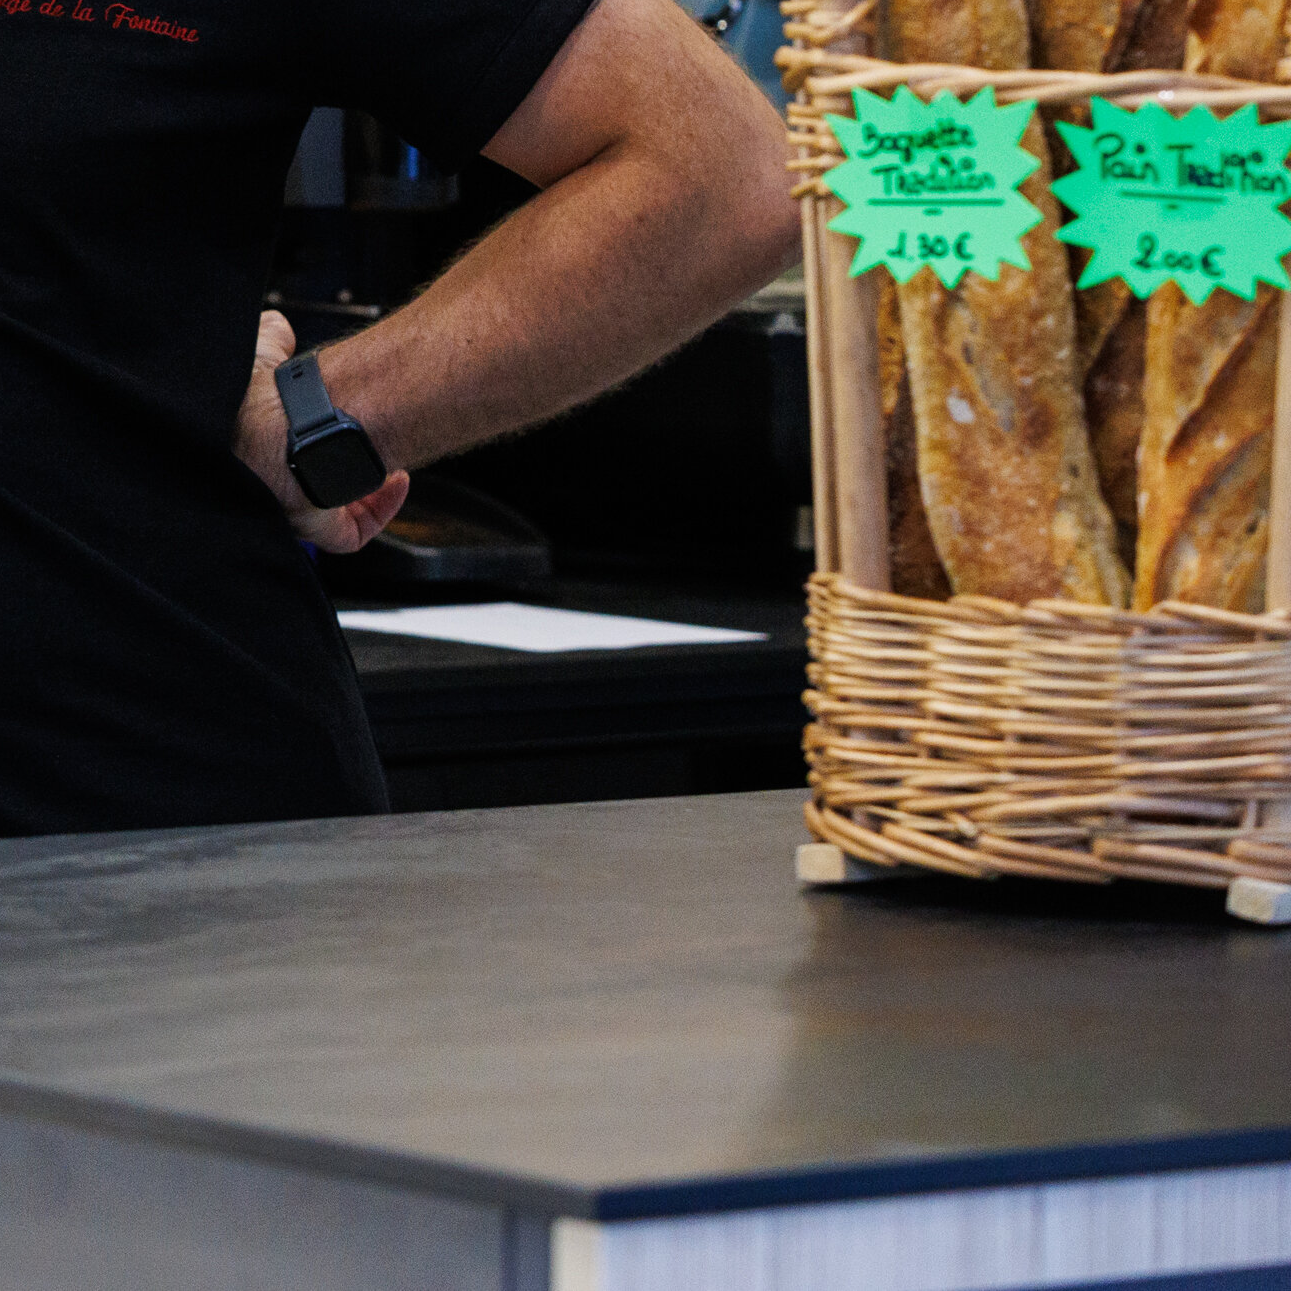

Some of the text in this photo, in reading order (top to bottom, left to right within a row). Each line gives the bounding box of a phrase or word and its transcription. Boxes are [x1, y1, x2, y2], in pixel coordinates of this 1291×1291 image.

[71, 0, 96, 22] la
[106, 3, 199, 42] Fontaine
[1094, 132, 1159, 184] Pain
